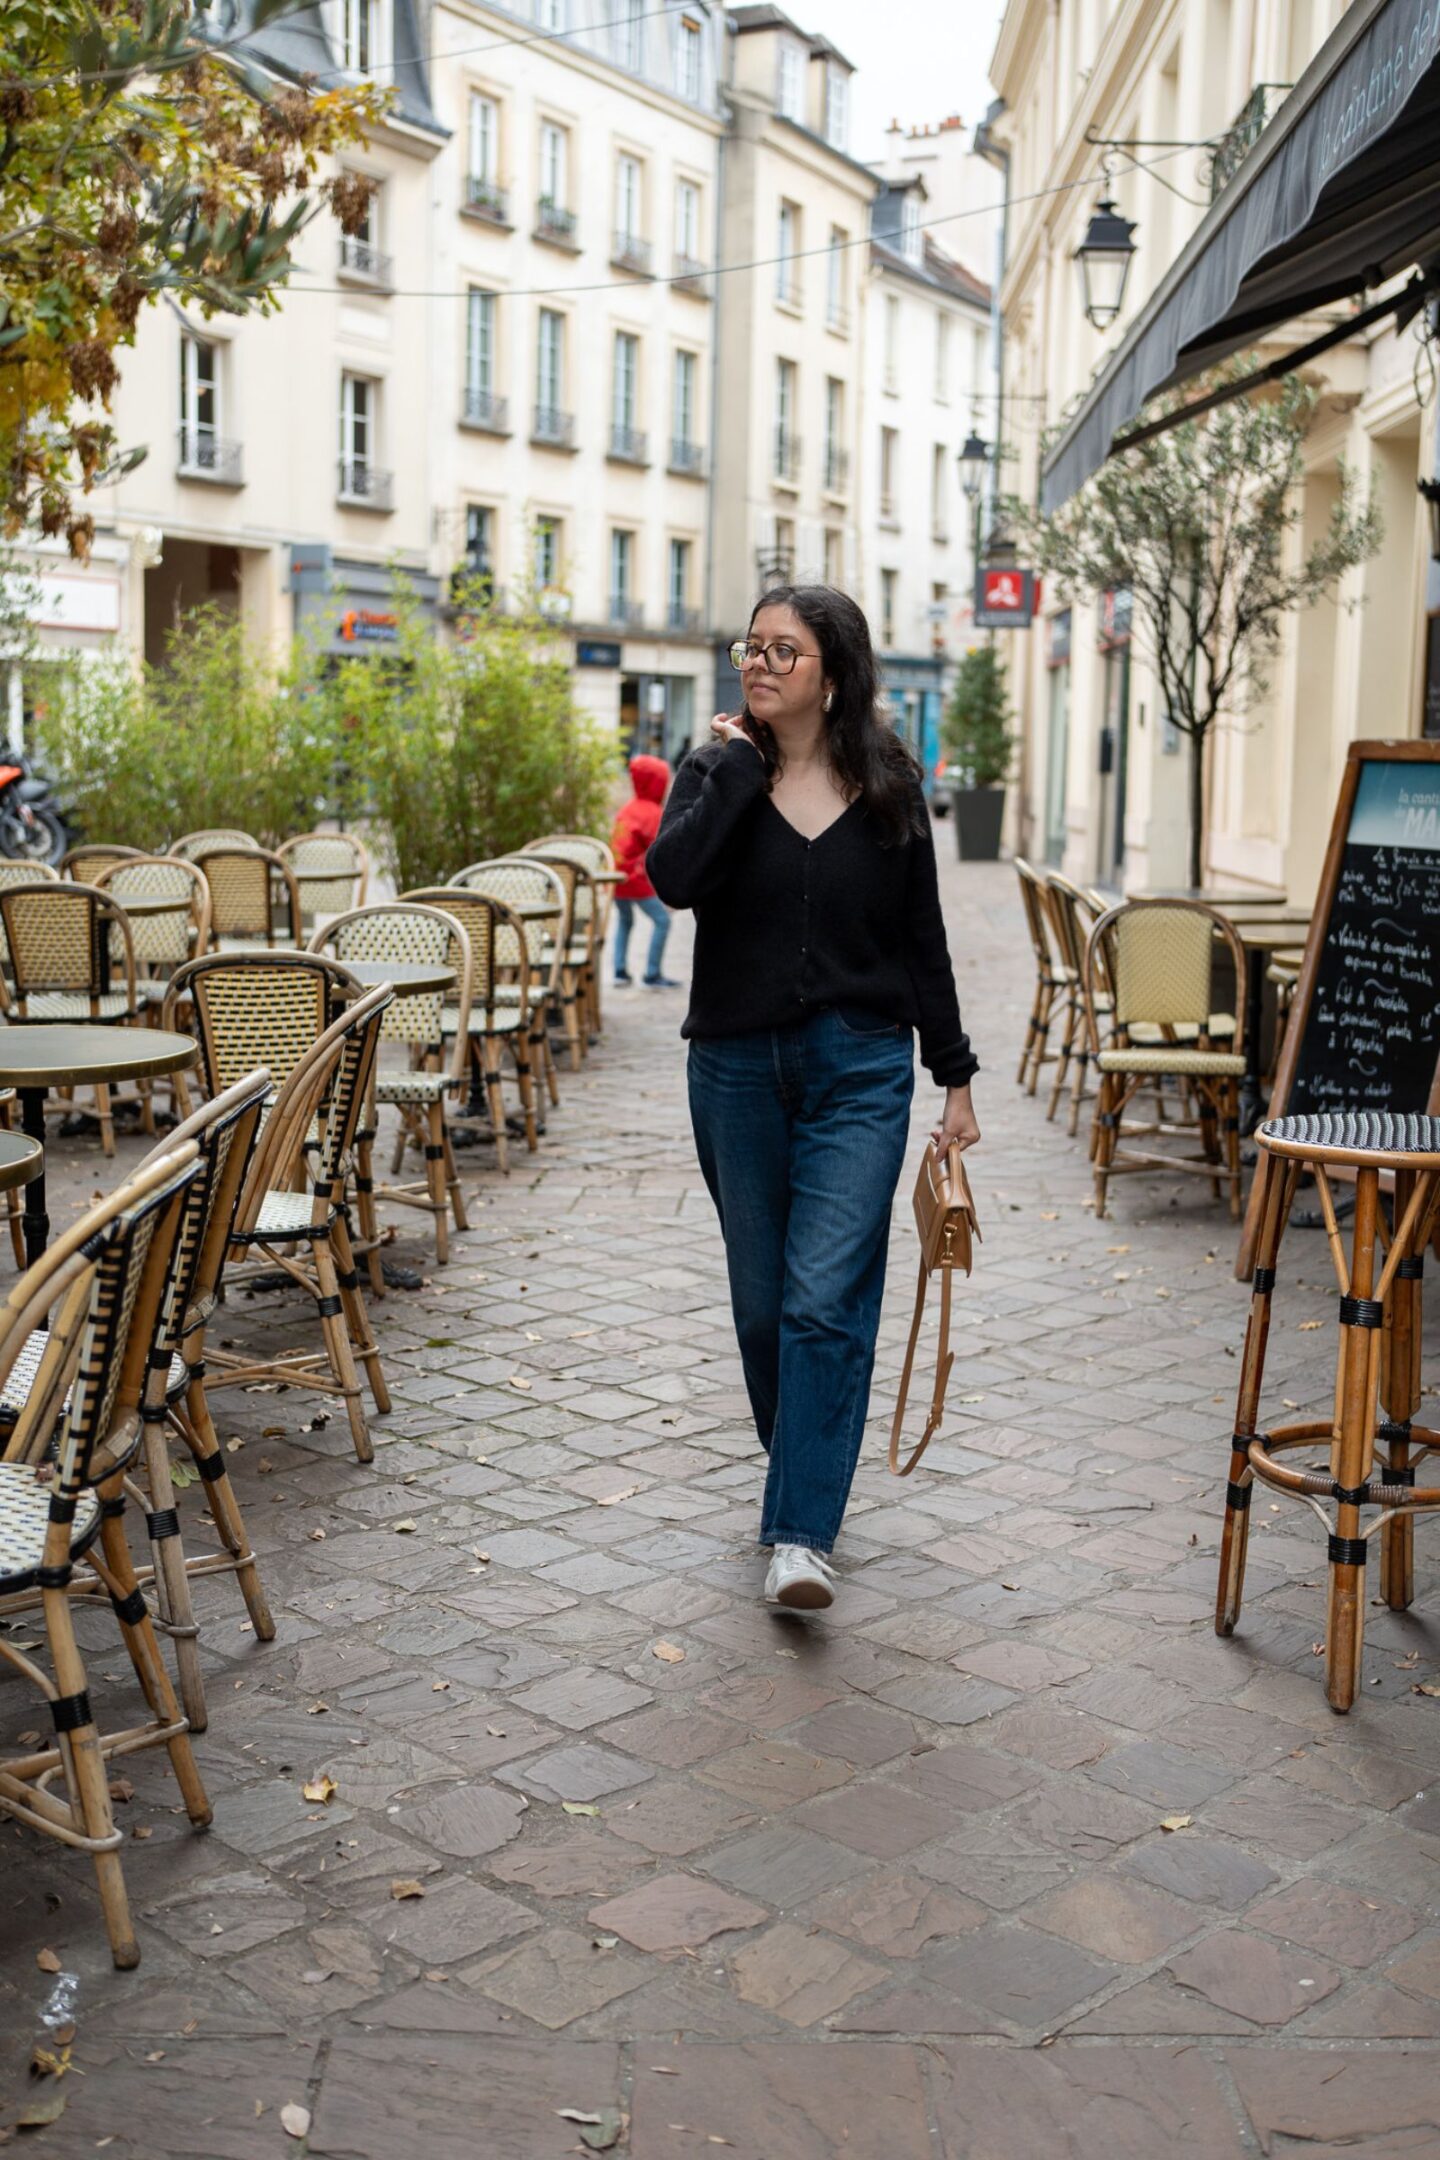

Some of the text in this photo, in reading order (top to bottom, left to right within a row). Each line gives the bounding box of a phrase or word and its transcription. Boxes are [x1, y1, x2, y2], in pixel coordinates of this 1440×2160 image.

[1333, 43, 1404, 154] cantine
[1408, 0, 1431, 71] de
[1403, 807, 1440, 839] MA
